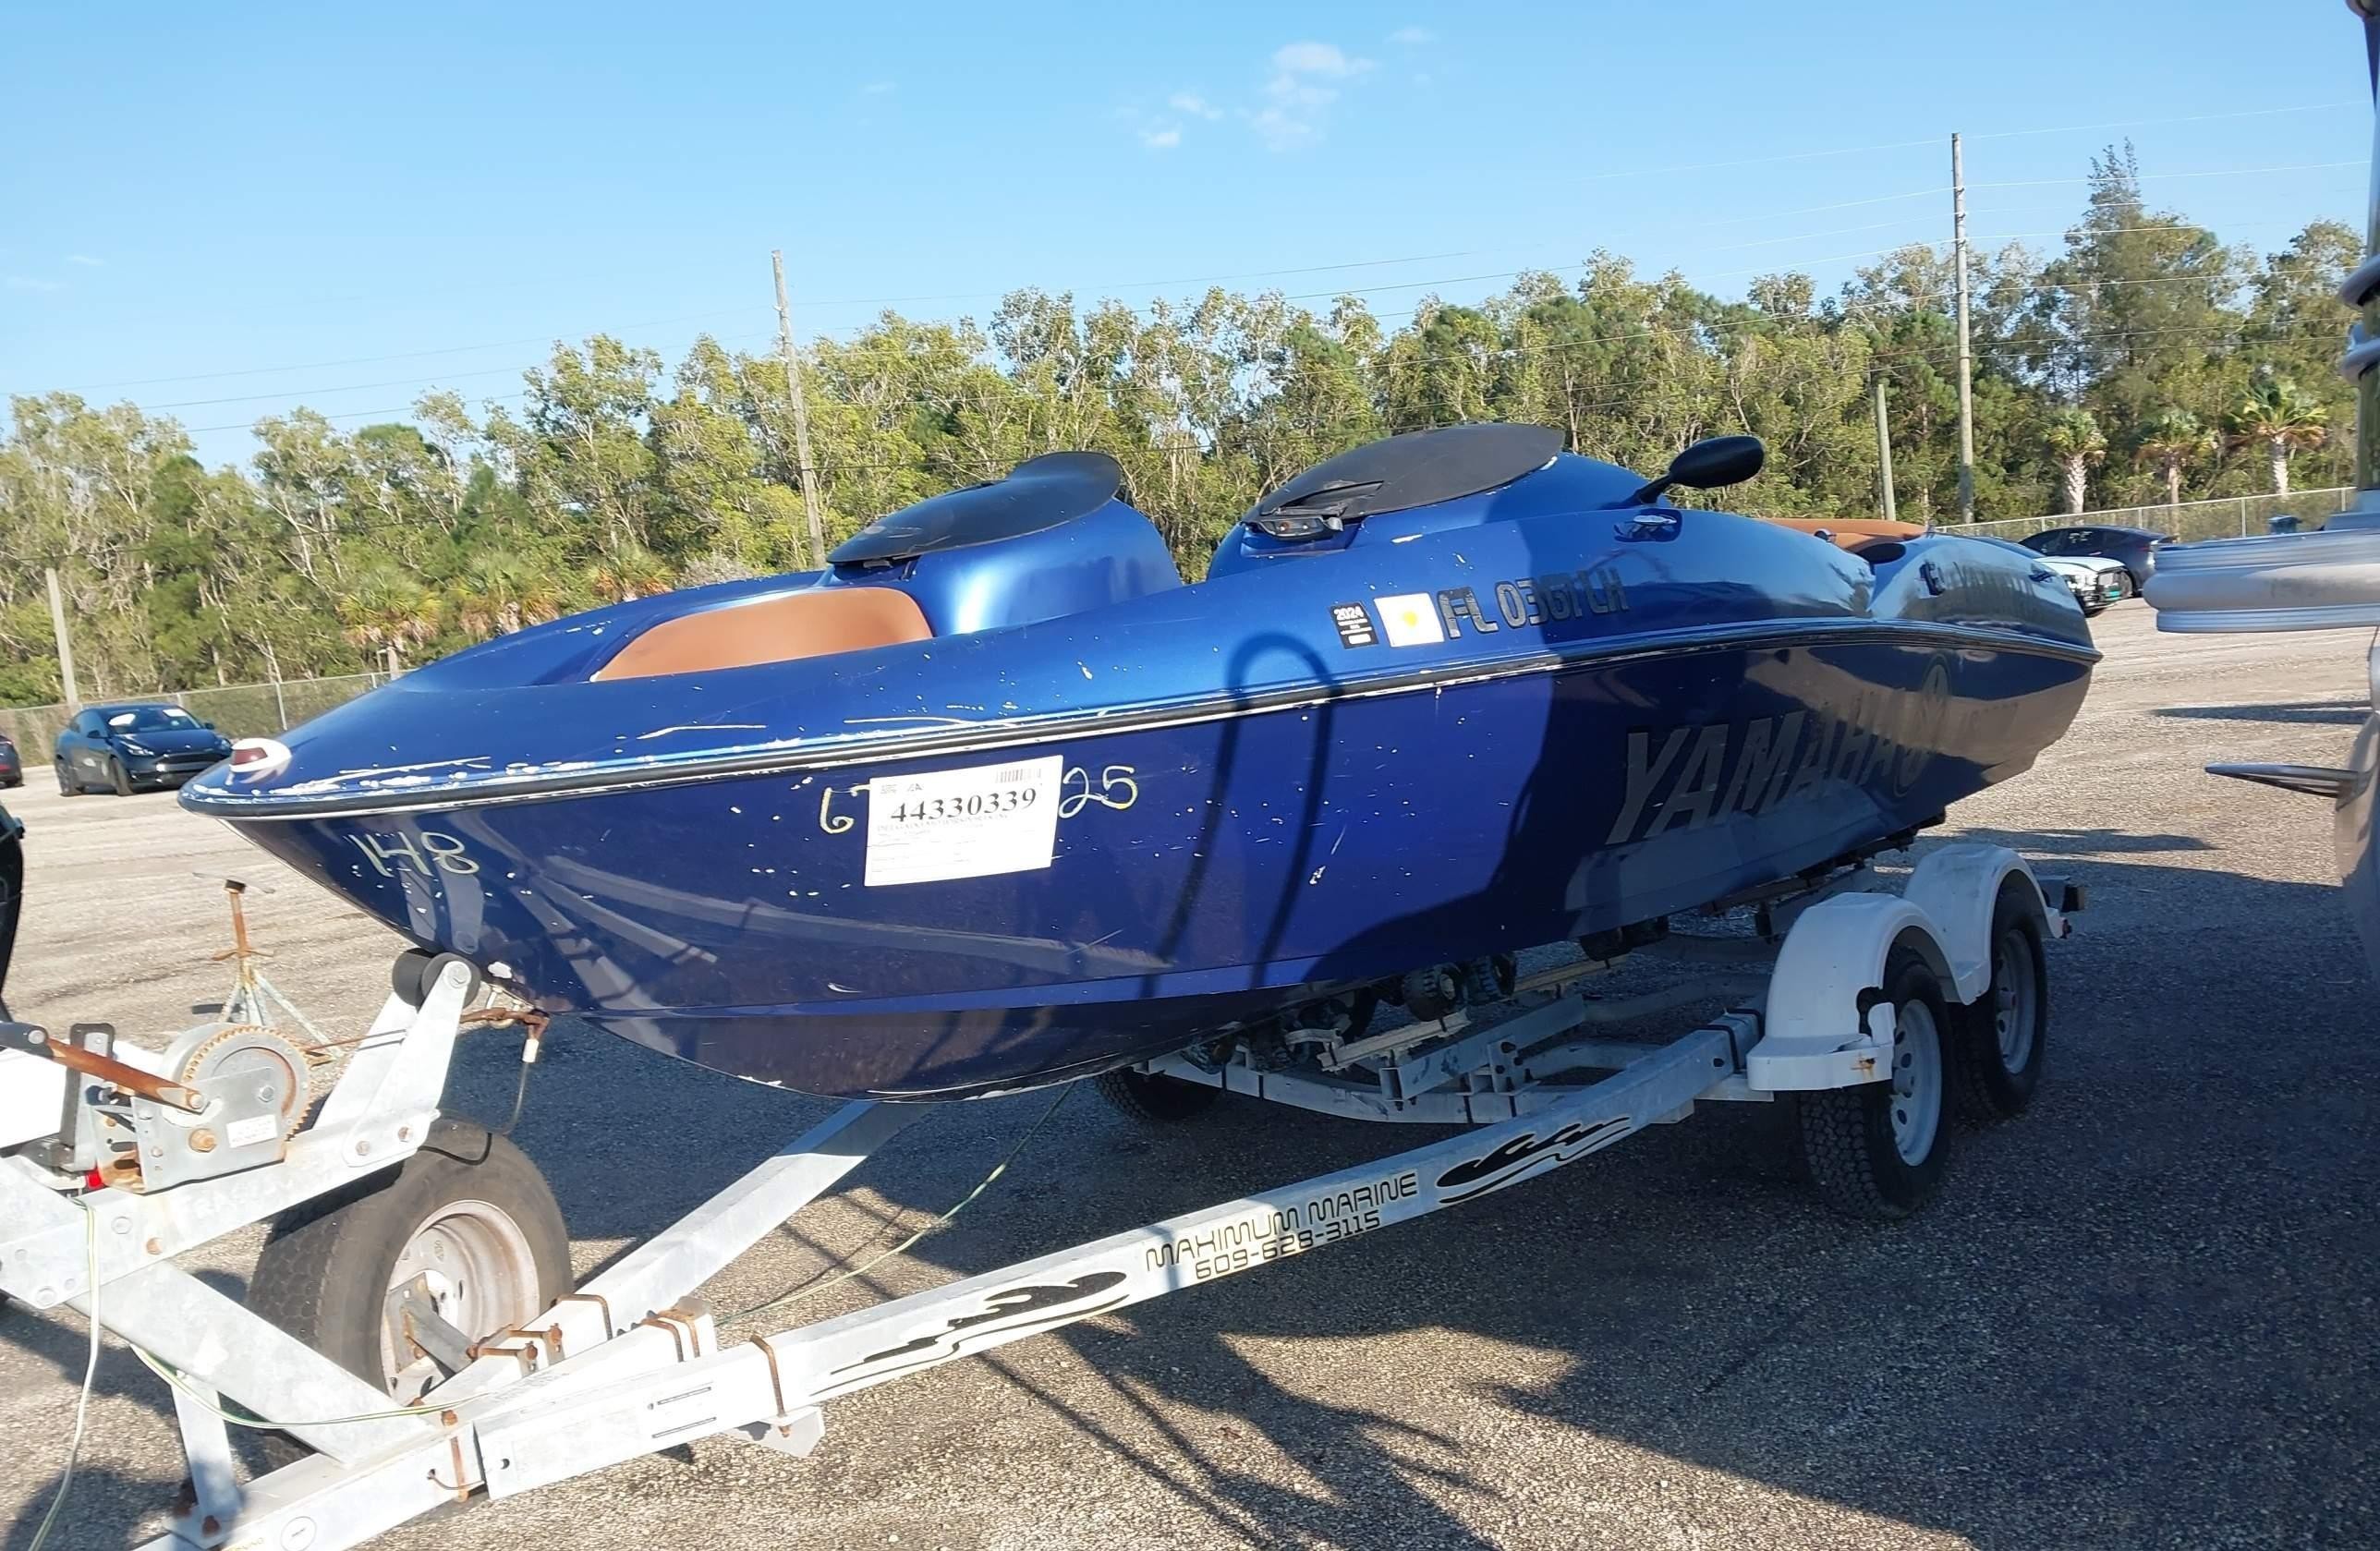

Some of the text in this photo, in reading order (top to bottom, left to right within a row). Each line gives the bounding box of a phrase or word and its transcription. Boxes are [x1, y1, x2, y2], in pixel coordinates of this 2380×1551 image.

[1333, 606, 1365, 621] 2024
[1437, 586, 1500, 640] FL
[1058, 766, 1138, 818] 25
[1605, 688, 1905, 846] YAMAHA
[890, 787, 1038, 823] 44330339
[1145, 1172, 1419, 1271] MAXIMUM MARINE
[1195, 1209, 1382, 1279] 609-628-3115
